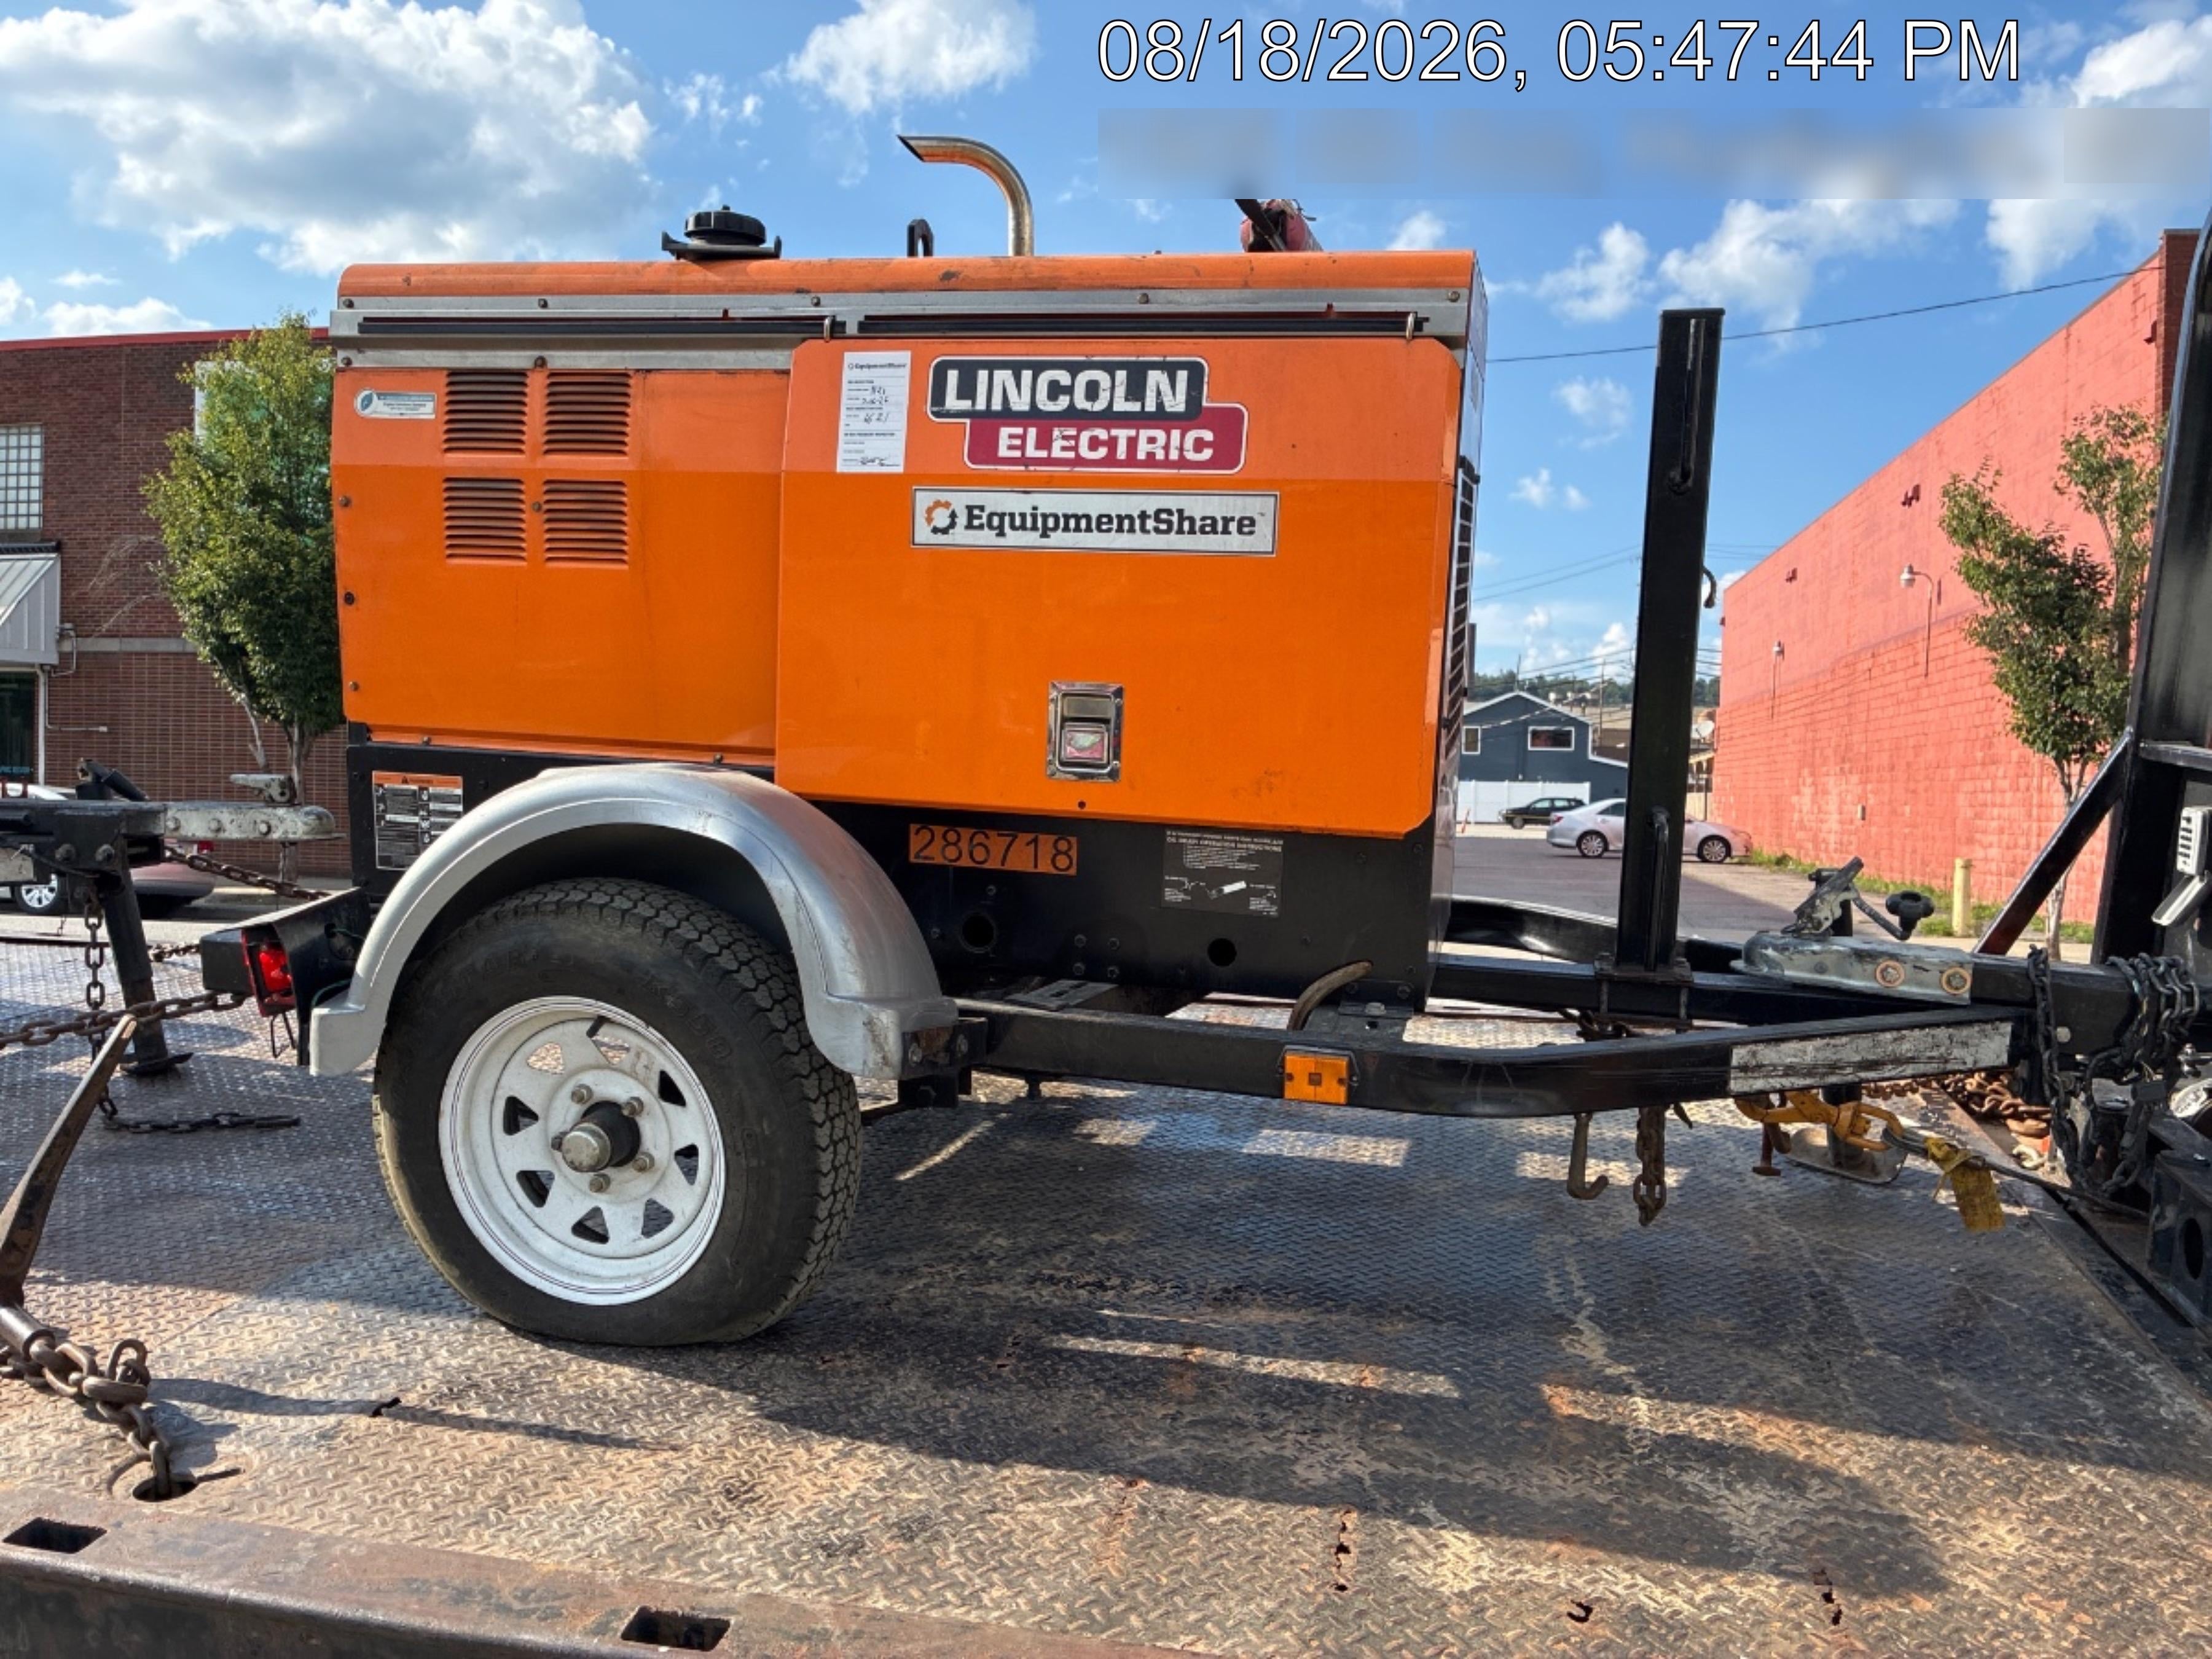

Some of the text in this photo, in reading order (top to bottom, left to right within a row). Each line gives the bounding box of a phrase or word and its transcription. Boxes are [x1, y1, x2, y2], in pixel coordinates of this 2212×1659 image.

[945, 369, 1188, 412] LINCOLN
[997, 426, 1215, 461] ELECTRIC
[963, 504, 1257, 538] EquipmentShare
[914, 825, 1073, 872] 286718
